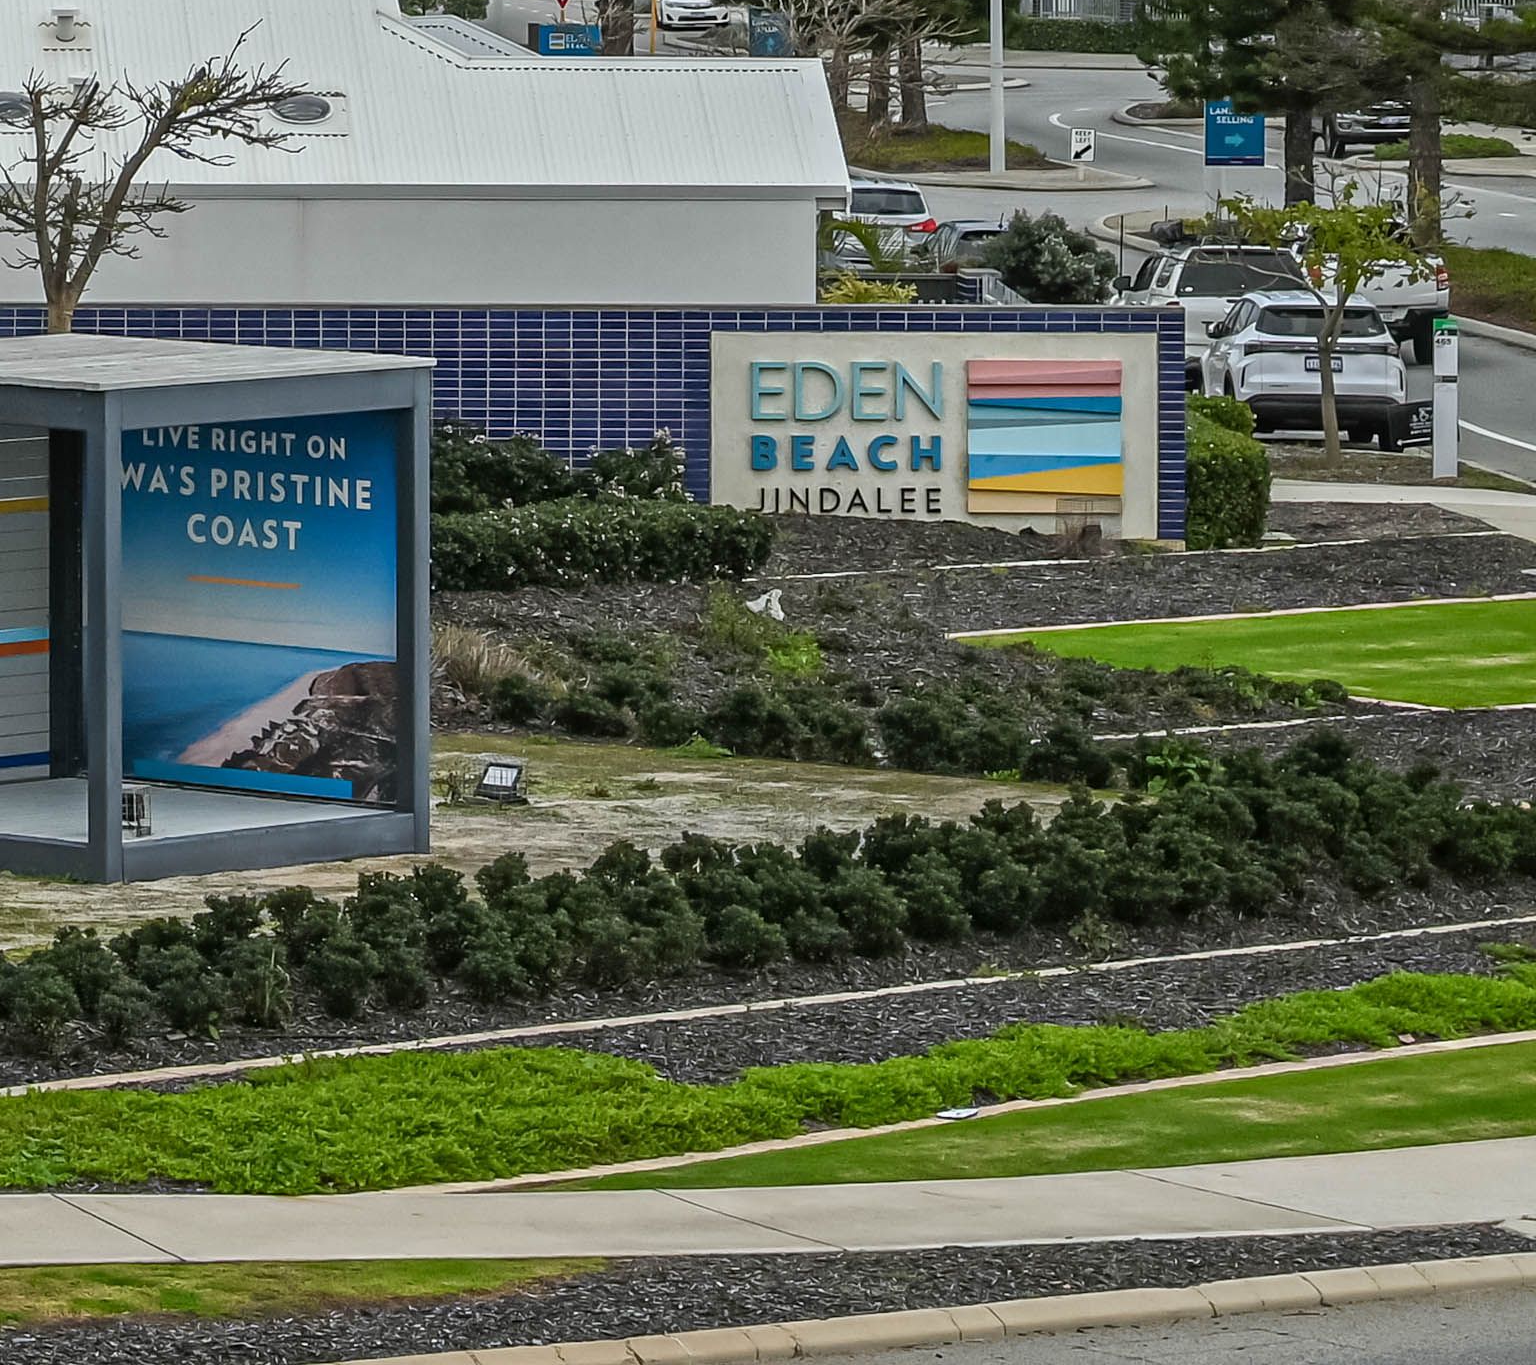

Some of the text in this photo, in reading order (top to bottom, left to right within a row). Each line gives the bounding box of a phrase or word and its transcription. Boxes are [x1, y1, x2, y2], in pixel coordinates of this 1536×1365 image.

[750, 361, 943, 422] EDEN
[142, 426, 346, 461] LIVE RIGHT ON
[750, 435, 942, 471] BEACH
[121, 461, 372, 511] WA'S PRISTINE
[755, 487, 942, 514] JINDALEE
[187, 513, 302, 551] COAST
